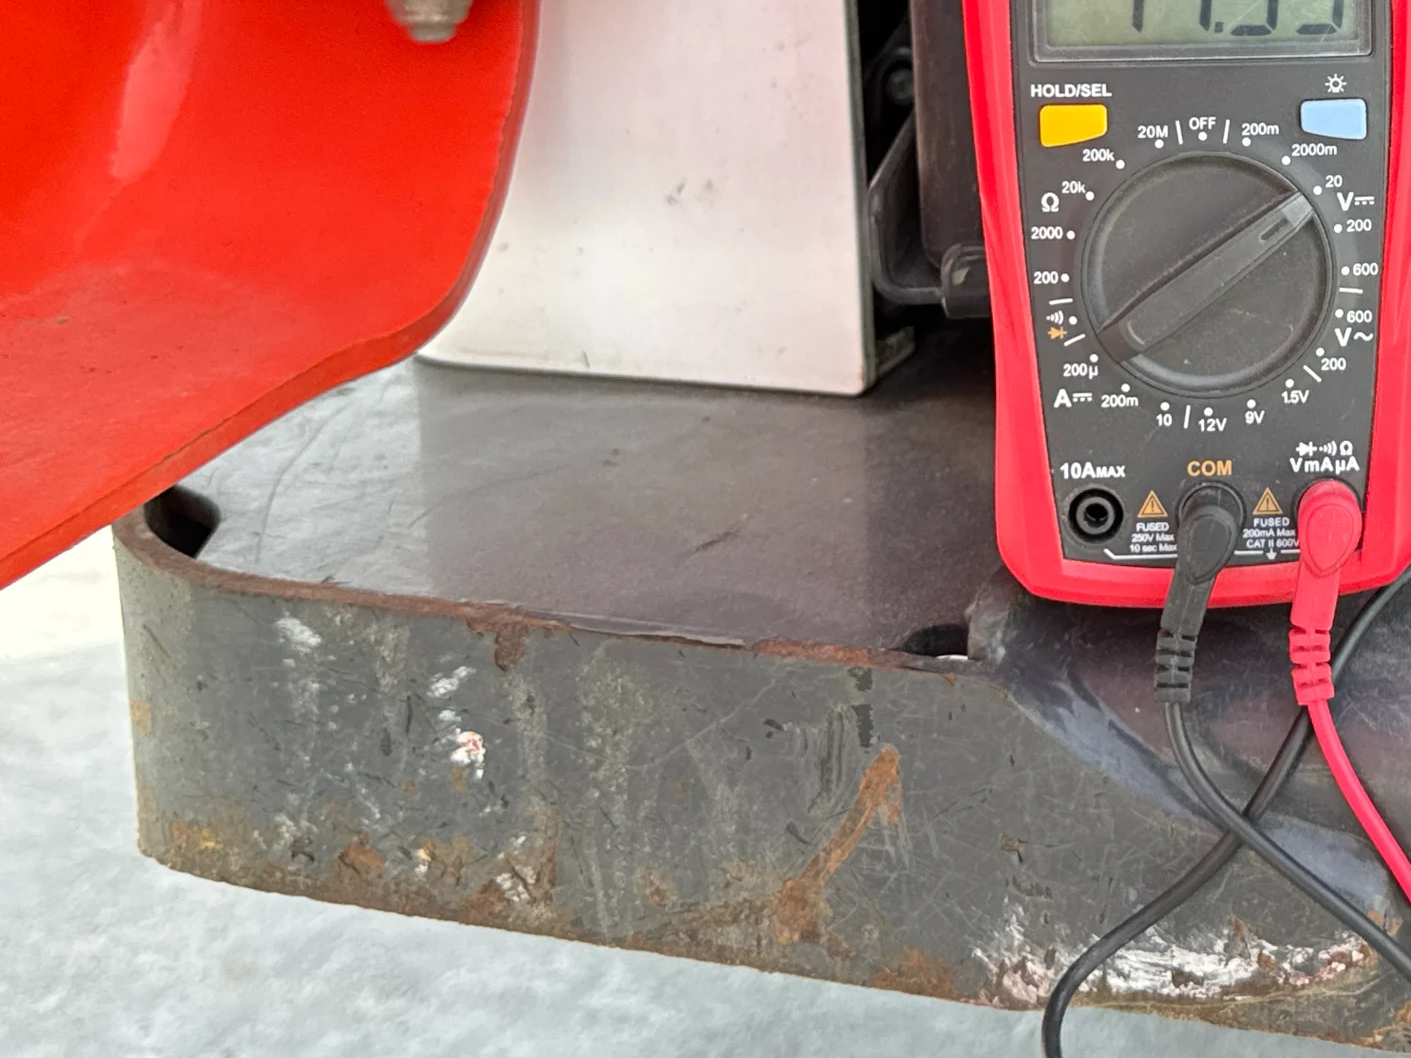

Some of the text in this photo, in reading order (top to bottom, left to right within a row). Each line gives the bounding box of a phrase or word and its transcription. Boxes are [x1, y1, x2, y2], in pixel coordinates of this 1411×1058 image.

[1031, 84, 1112, 99] HOLD/SEL
[1189, 117, 1216, 130] OFF
[1242, 122, 1279, 135] 200m
[1138, 125, 1168, 138] 20M
[1082, 149, 1114, 162] 200k
[1292, 143, 1337, 156] 2000m
[1326, 175, 1343, 187] 20
[1062, 181, 1085, 194] 20k
[1347, 220, 1372, 232] 200
[1031, 227, 1063, 239] 2000
[1353, 263, 1378, 275] 600
[1034, 272, 1058, 284] 200
[1347, 310, 1372, 322] 600
[1321, 358, 1346, 370] 200
[1101, 395, 1138, 407] 200m
[1282, 390, 1309, 404] 1.5V
[1156, 414, 1172, 426] 10
[1245, 410, 1264, 424] 9V
[1199, 418, 1227, 432] 12V
[1187, 460, 1232, 476] COM
[1136, 522, 1169, 532] FUSED
[1254, 517, 1290, 527] FUSED
[1132, 532, 1174, 542] 250V Max
[1243, 527, 1295, 538] 200mA Max
[1130, 544, 1140, 553] 10
[1159, 543, 1177, 551] Max
[1246, 539, 1265, 548] CAT
[1276, 538, 1299, 547] 600V
